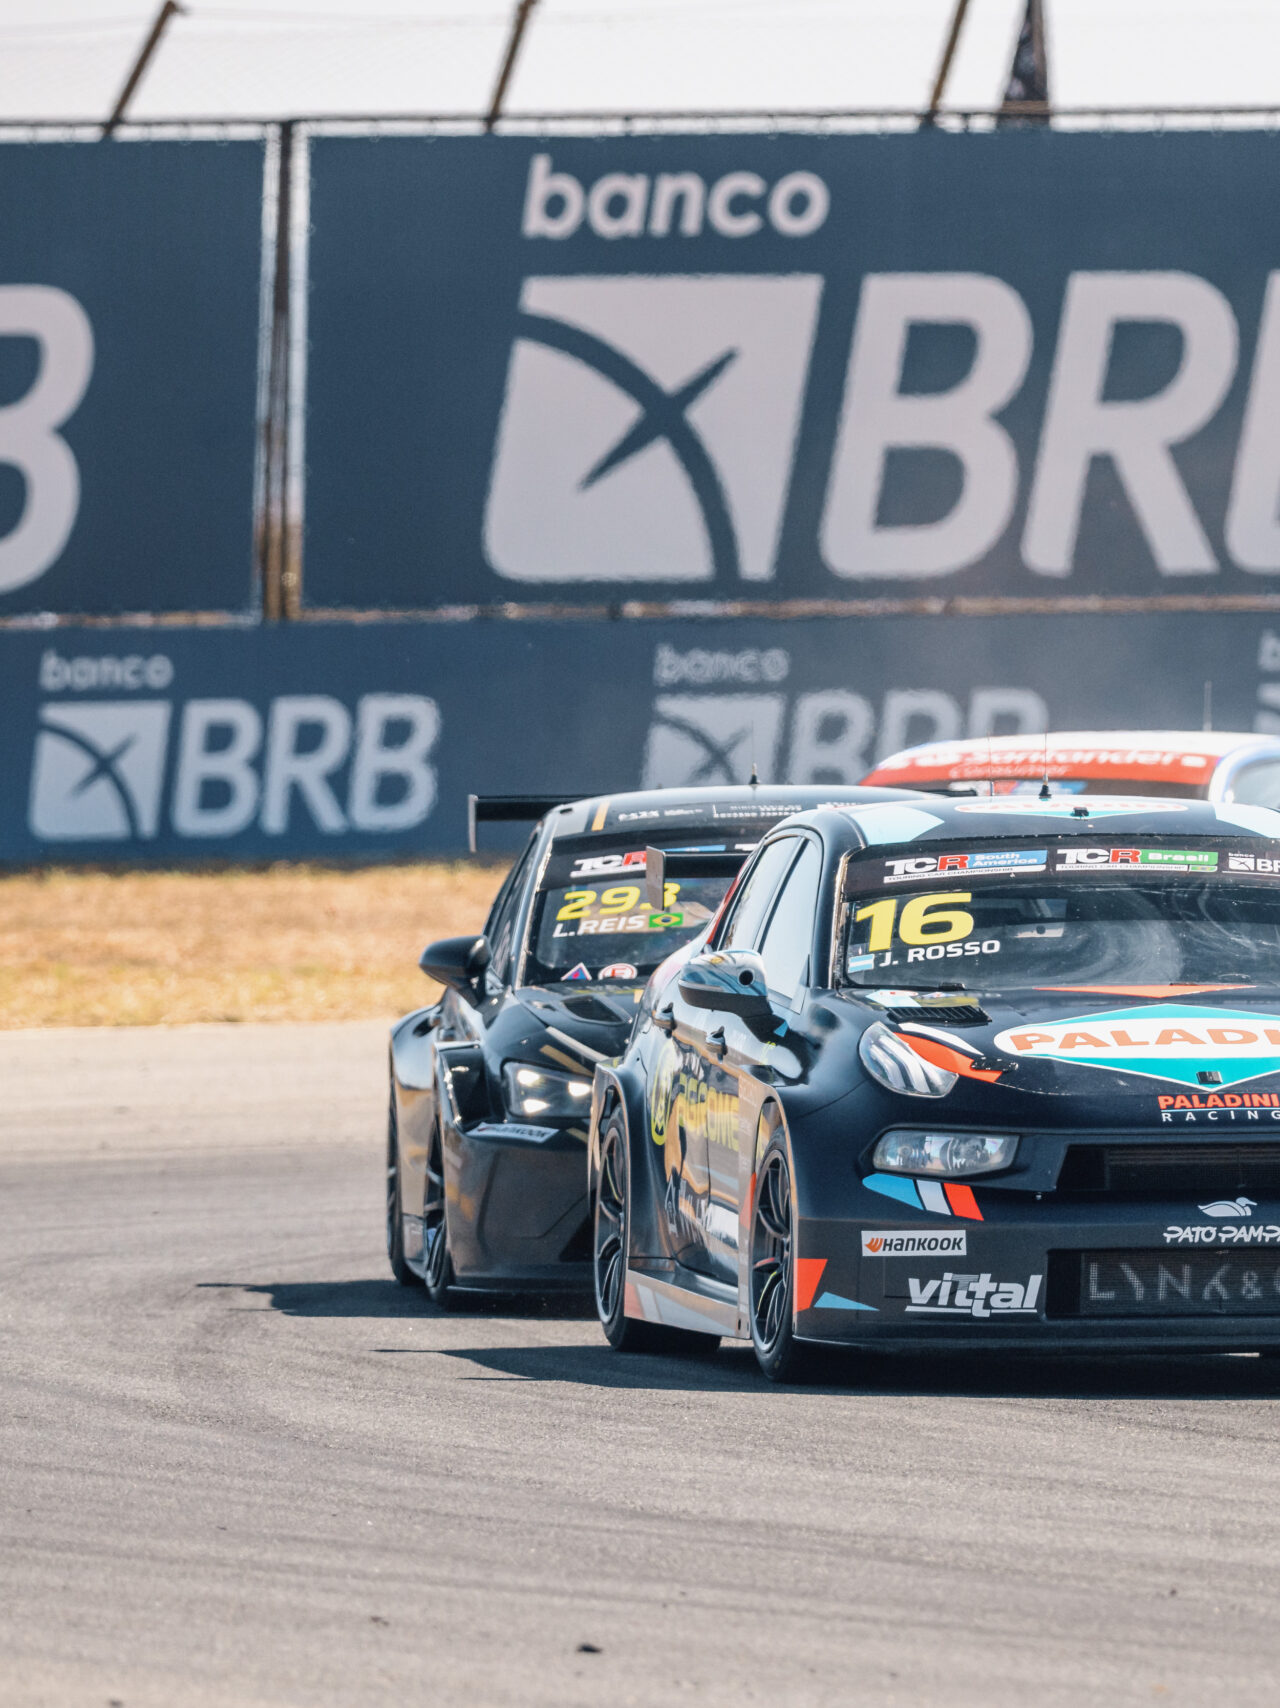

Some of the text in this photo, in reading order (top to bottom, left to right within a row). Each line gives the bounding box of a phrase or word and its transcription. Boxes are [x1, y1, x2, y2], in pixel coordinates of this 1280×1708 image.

[523, 153, 831, 241] banco
[39, 648, 174, 691] banco
[654, 643, 791, 687] banco
[171, 692, 441, 839] BRB
[885, 852, 1020, 875] TCR South
[972, 858, 1038, 867] America
[1056, 848, 1141, 864] TCR
[856, 892, 974, 952] 16
[879, 939, 1001, 967] J. ROSSO
[1157, 1093, 1280, 1110] PALADINI
[1163, 1225, 1217, 1243] PATO
